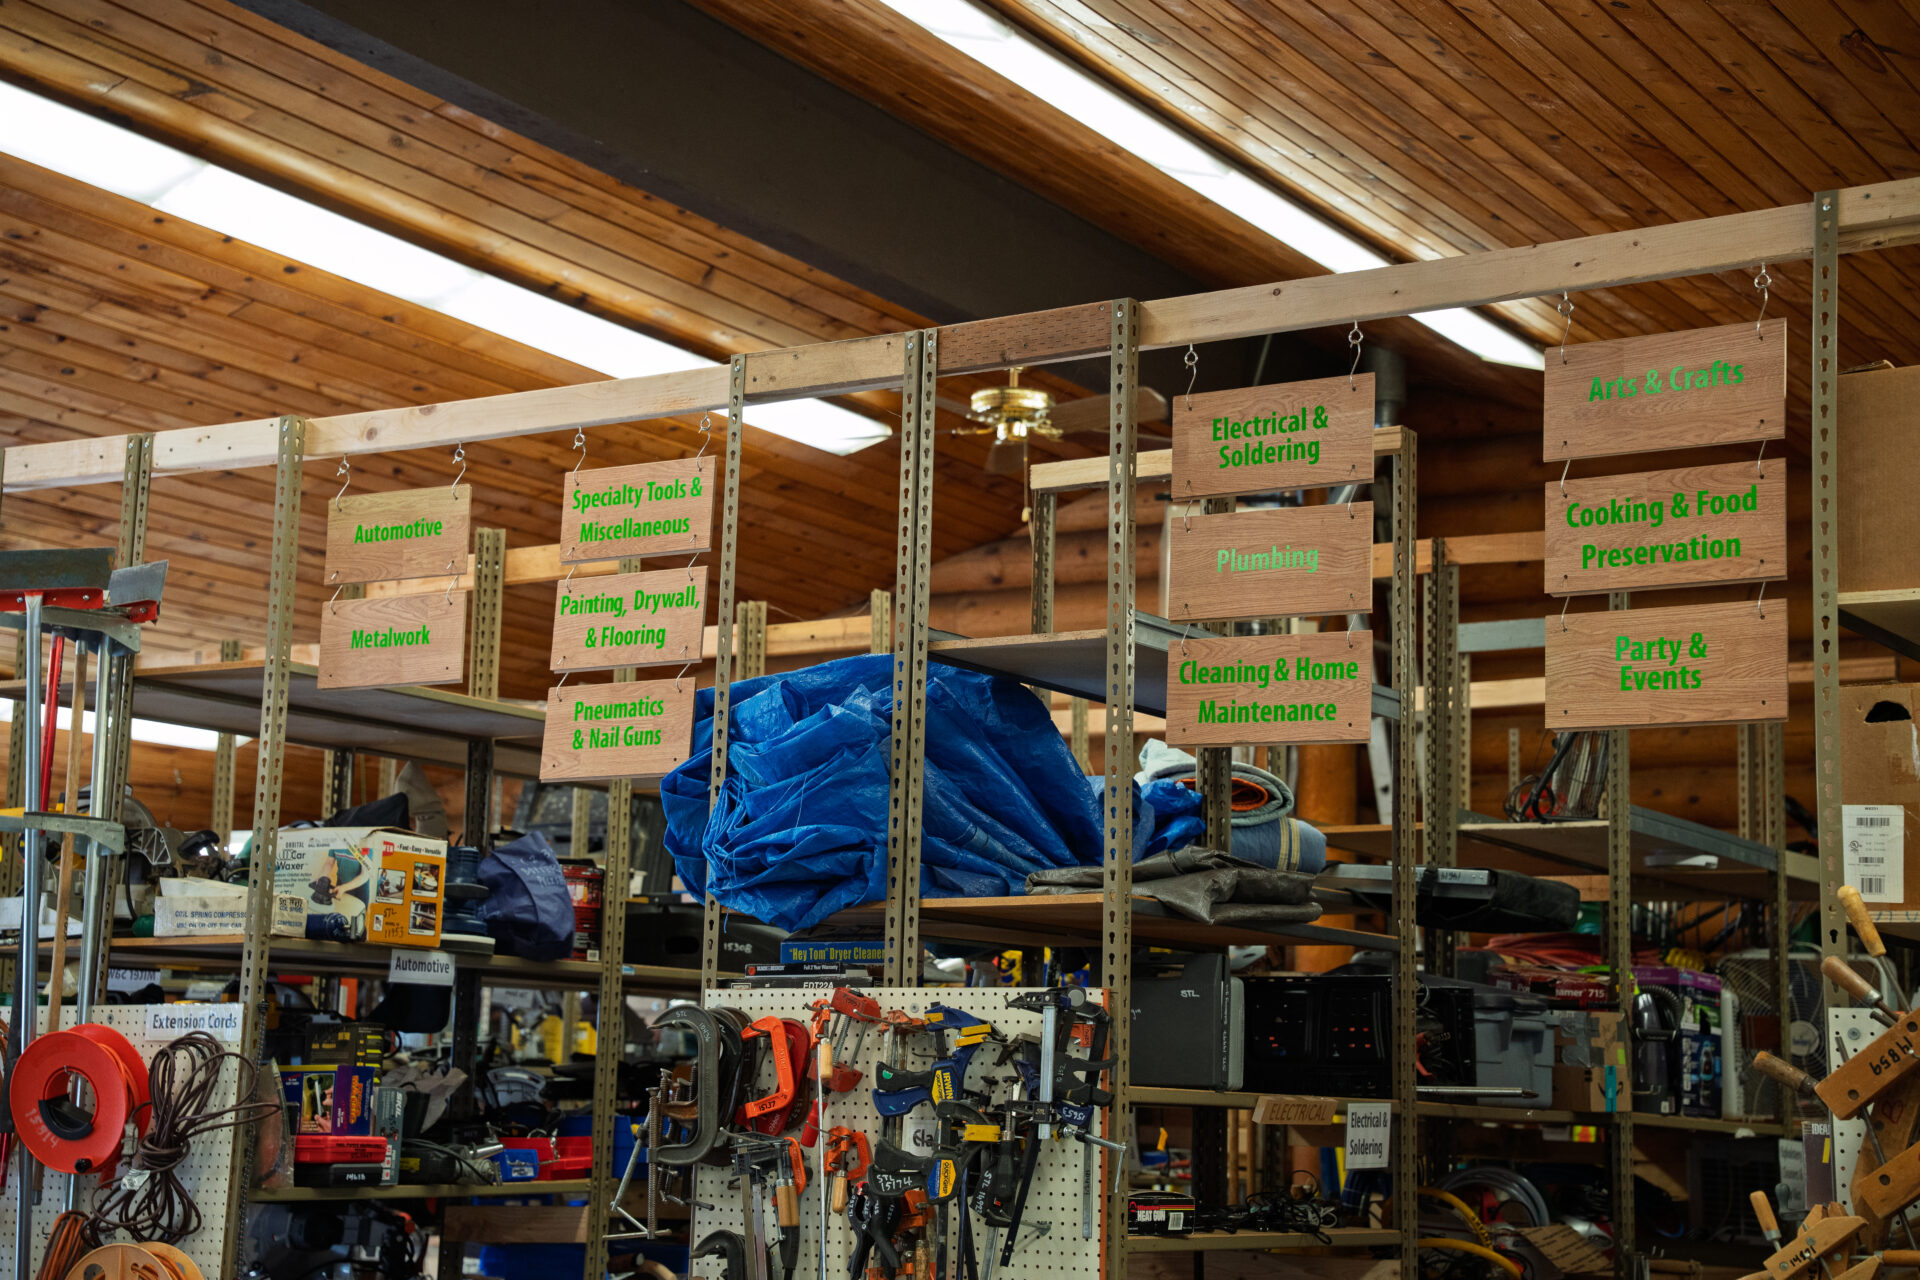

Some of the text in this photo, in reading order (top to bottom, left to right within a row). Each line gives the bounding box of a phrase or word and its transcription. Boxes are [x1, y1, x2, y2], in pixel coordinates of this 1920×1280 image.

[1588, 360, 1744, 402] Arts & Crafts
[1213, 406, 1328, 441] Electrical &
[1219, 435, 1320, 469] Soldering
[572, 477, 702, 511] Specialty Tools &
[1567, 484, 1757, 528] Cooking & Food
[354, 517, 442, 544] Automotive
[580, 517, 690, 543] Miscellaneous
[1218, 545, 1318, 573] Plumbing
[1582, 535, 1741, 569] Preservation
[560, 585, 701, 618] Painting, Drywall,
[351, 624, 430, 649] Metalwork
[585, 624, 666, 649] & Flooring
[1616, 632, 1707, 664] Party &
[1179, 657, 1358, 688] Cleaning & Home
[1621, 663, 1701, 691] Events
[574, 696, 664, 722] Pneumatics
[1198, 700, 1336, 724] Maintenance
[572, 726, 661, 750] & Nail Guns
[292, 850, 305, 860] Car
[190, 911, 212, 919] SPRING
[395, 956, 450, 973] Automotive
[830, 947, 852, 960] Dryer
[1180, 990, 1200, 998] STL
[1588, 989, 1605, 998] 715
[153, 1012, 237, 1029] Extension Cords
[1869, 1036, 1913, 1077] 14859
[943, 1072, 953, 1100] IRWIN
[1269, 1103, 1327, 1121] ELECTRICAL
[1351, 1111, 1388, 1129] Electrical &
[1350, 1139, 1383, 1159] Soldering
[876, 1174, 894, 1183] STL
[881, 1176, 912, 1192] 15174
[982, 1170, 992, 1189] STL
[1137, 1210, 1166, 1222] HEAT GUN
